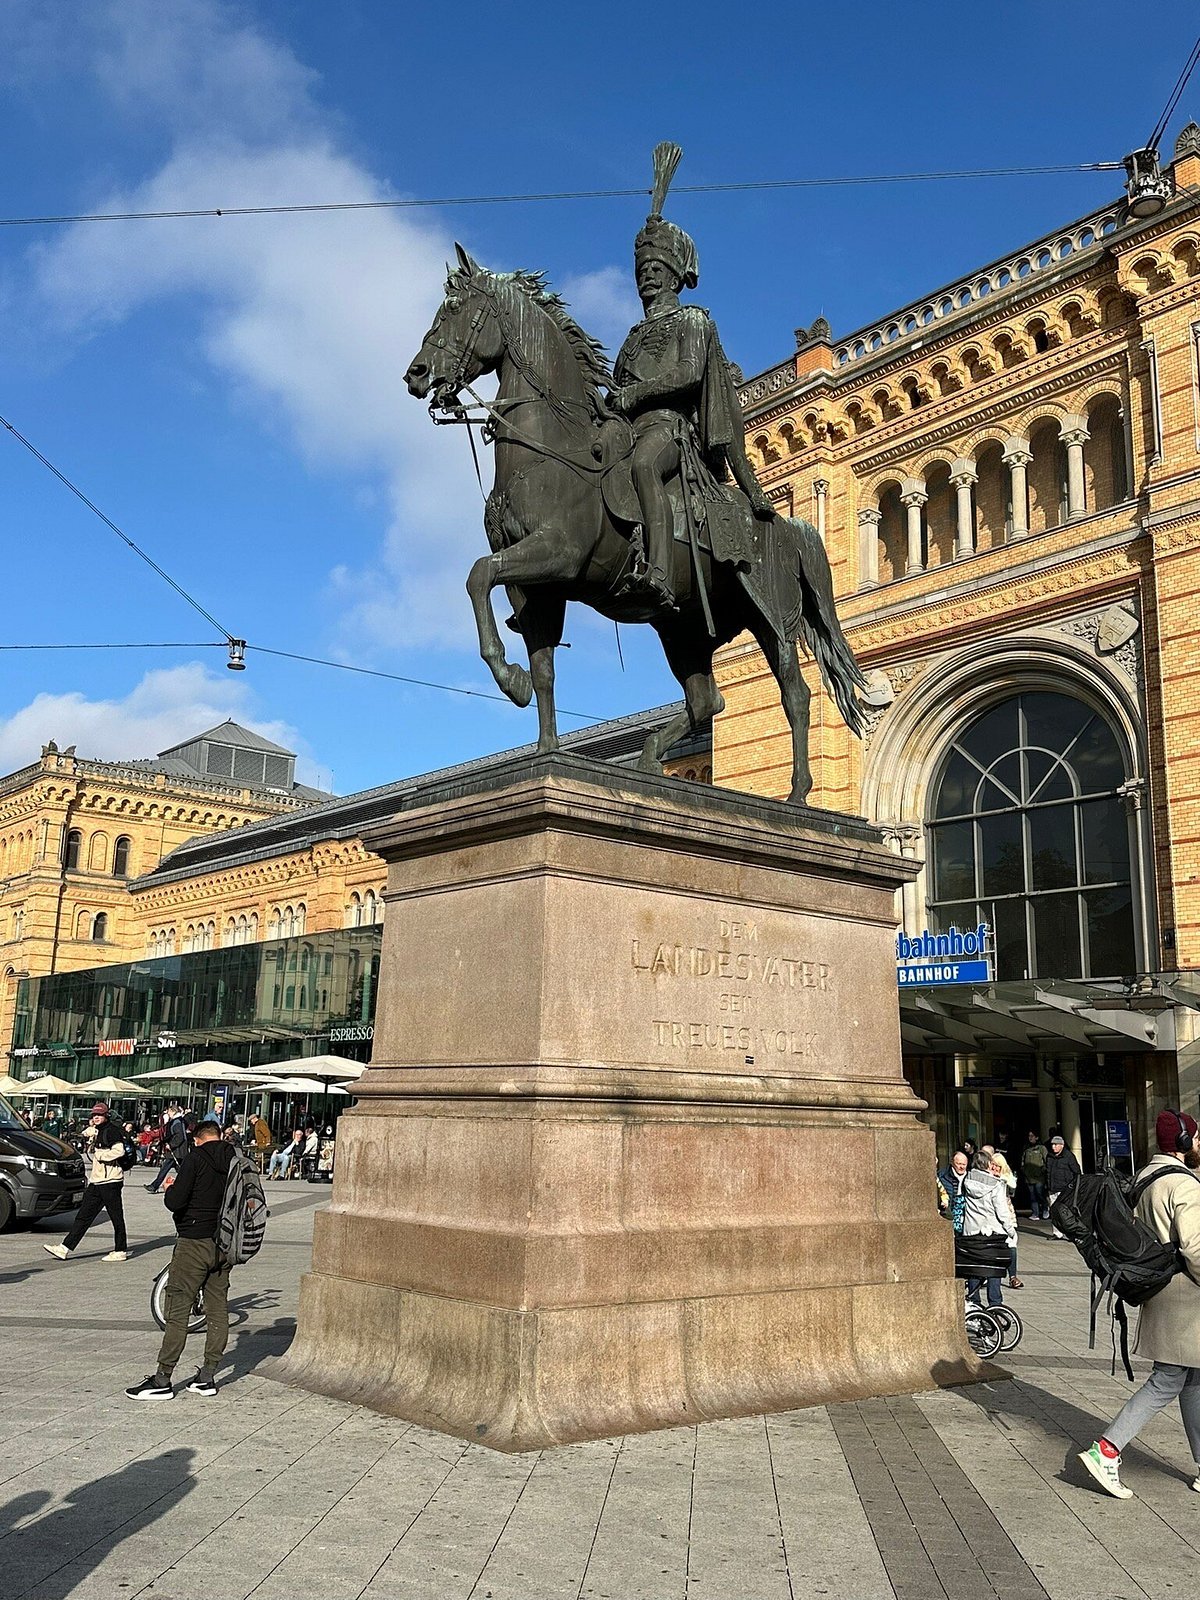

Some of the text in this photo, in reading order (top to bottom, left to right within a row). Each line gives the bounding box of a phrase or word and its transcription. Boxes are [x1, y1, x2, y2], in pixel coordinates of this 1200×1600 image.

[719, 919, 758, 942] DEM
[631, 938, 834, 992] LANDESVATER
[899, 965, 960, 983] BAHNHOF
[330, 1026, 374, 1041] ESPRESSO
[98, 1038, 137, 1057] DUNKIN'
